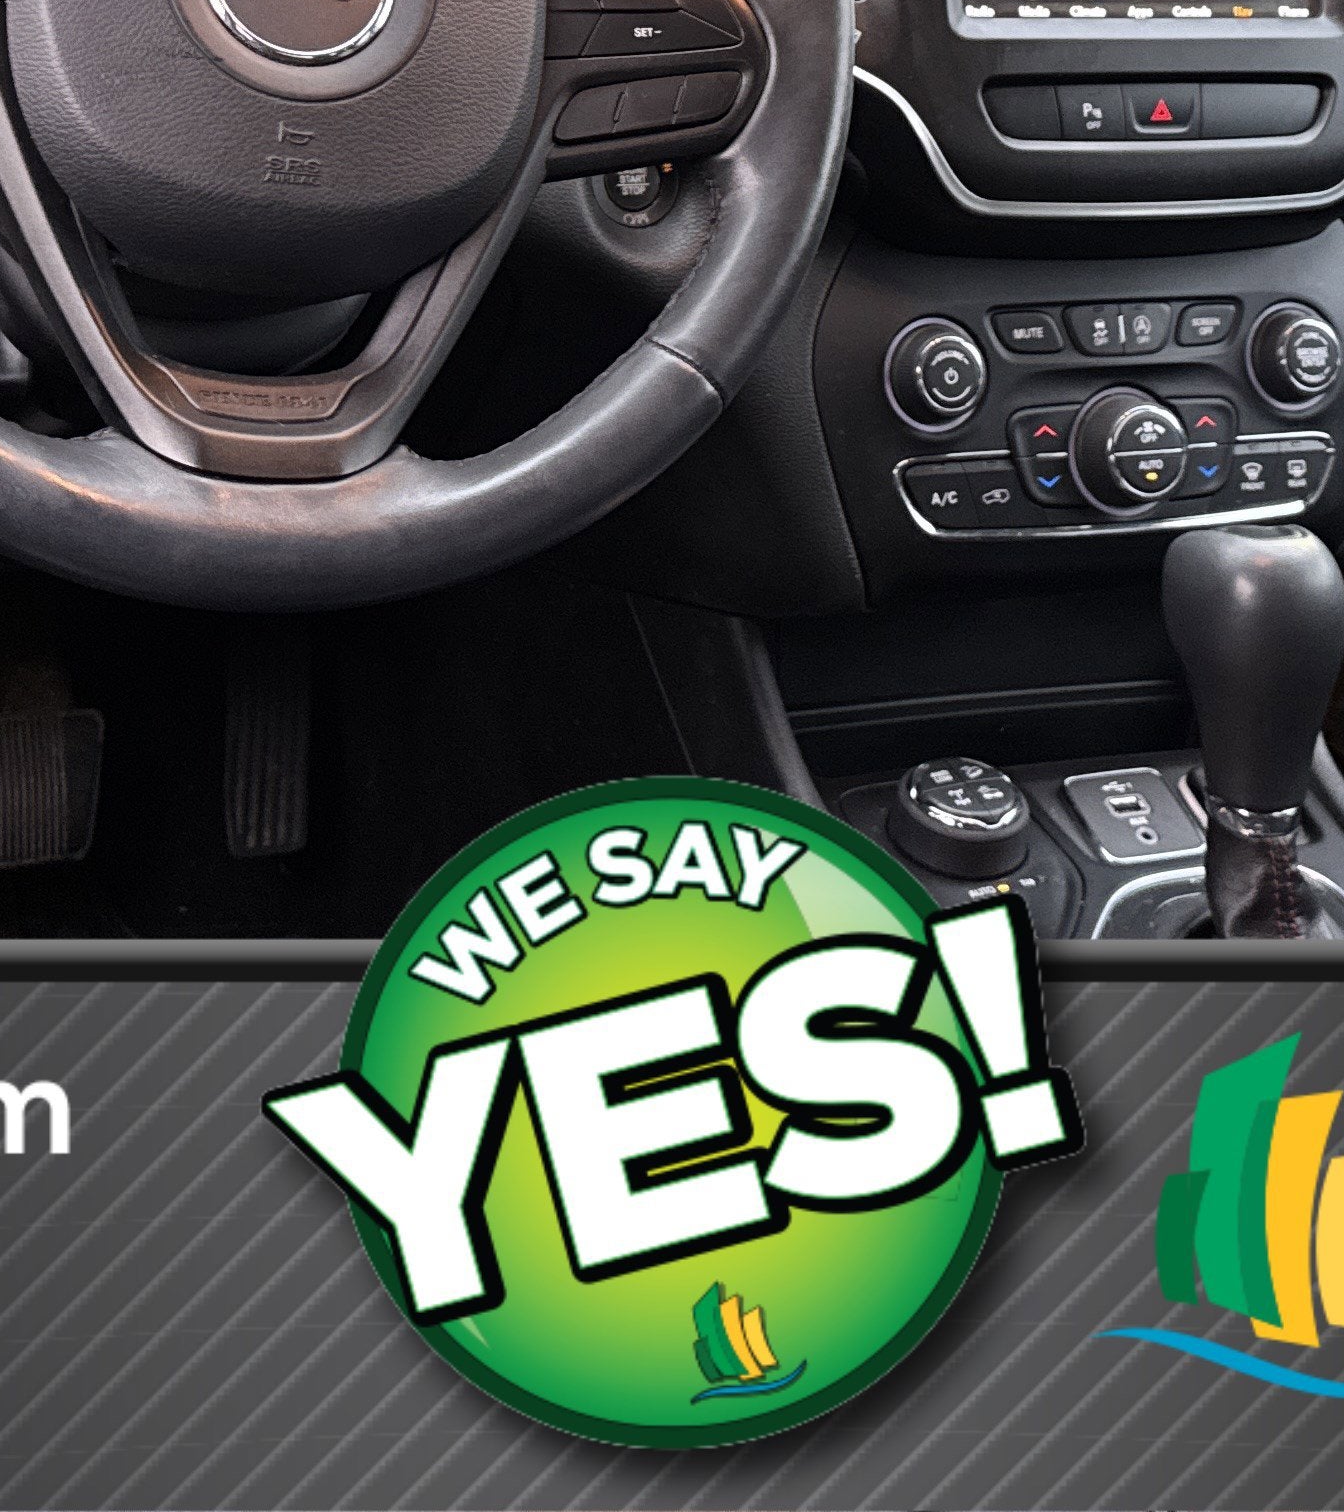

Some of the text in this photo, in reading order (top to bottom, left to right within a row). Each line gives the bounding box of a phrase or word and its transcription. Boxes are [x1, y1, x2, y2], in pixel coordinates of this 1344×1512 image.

[1012, 326, 1044, 340] MUTE
[1138, 459, 1164, 470] AUTO
[931, 490, 958, 508] A/C
